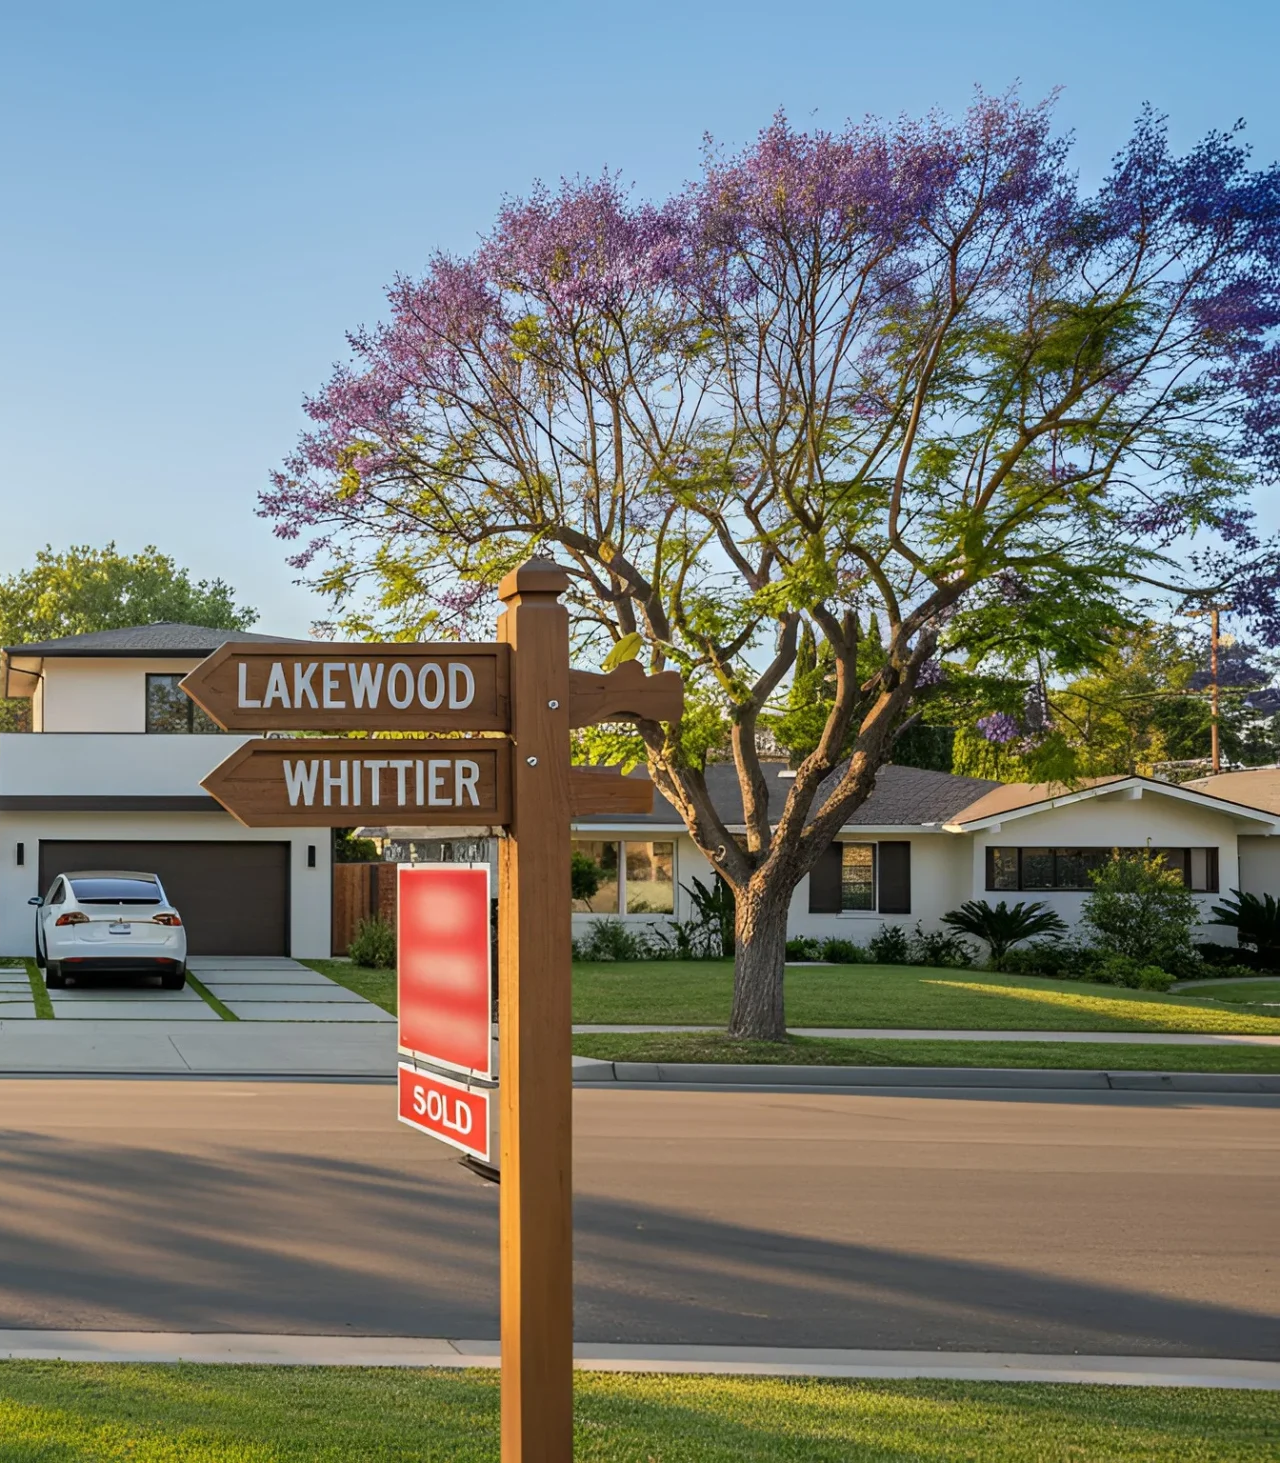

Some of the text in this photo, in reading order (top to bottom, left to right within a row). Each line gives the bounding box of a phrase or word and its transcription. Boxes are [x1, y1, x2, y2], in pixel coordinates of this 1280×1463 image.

[238, 662, 475, 710] LAKEWOOD
[283, 760, 480, 807] WHITTIER
[413, 1085, 472, 1135] SOLD
